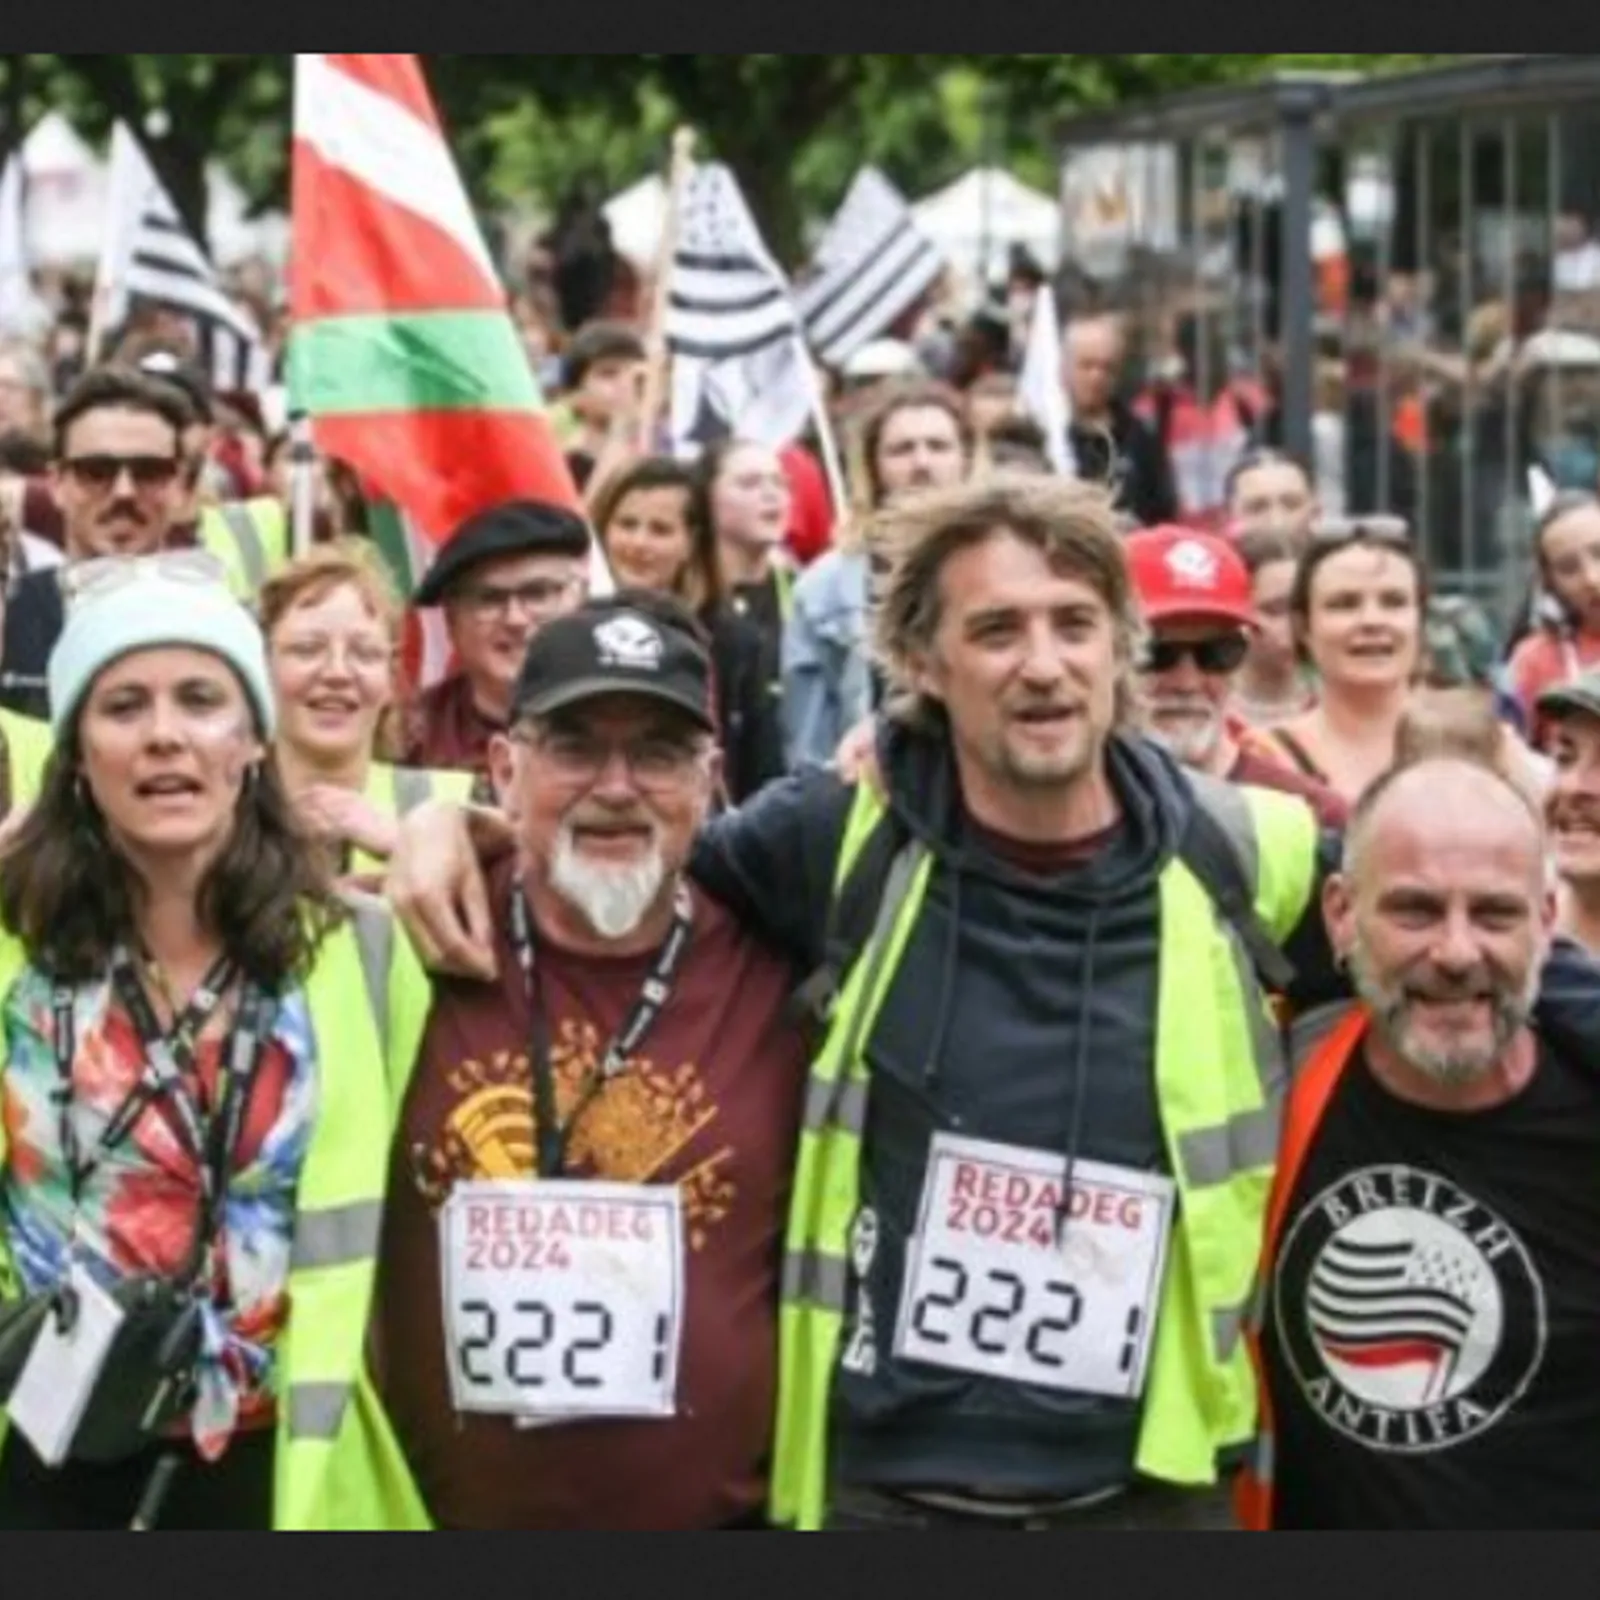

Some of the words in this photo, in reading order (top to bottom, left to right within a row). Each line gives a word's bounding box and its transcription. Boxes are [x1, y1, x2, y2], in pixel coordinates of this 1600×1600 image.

[465, 1204, 655, 1242] REDADEG
[946, 1200, 1052, 1246] 2024
[952, 1162, 1143, 1230] REDADEG
[1321, 1165, 1511, 1262] BREIZH
[465, 1240, 571, 1270] 2024
[1305, 1376, 1490, 1446] ANTIFA
